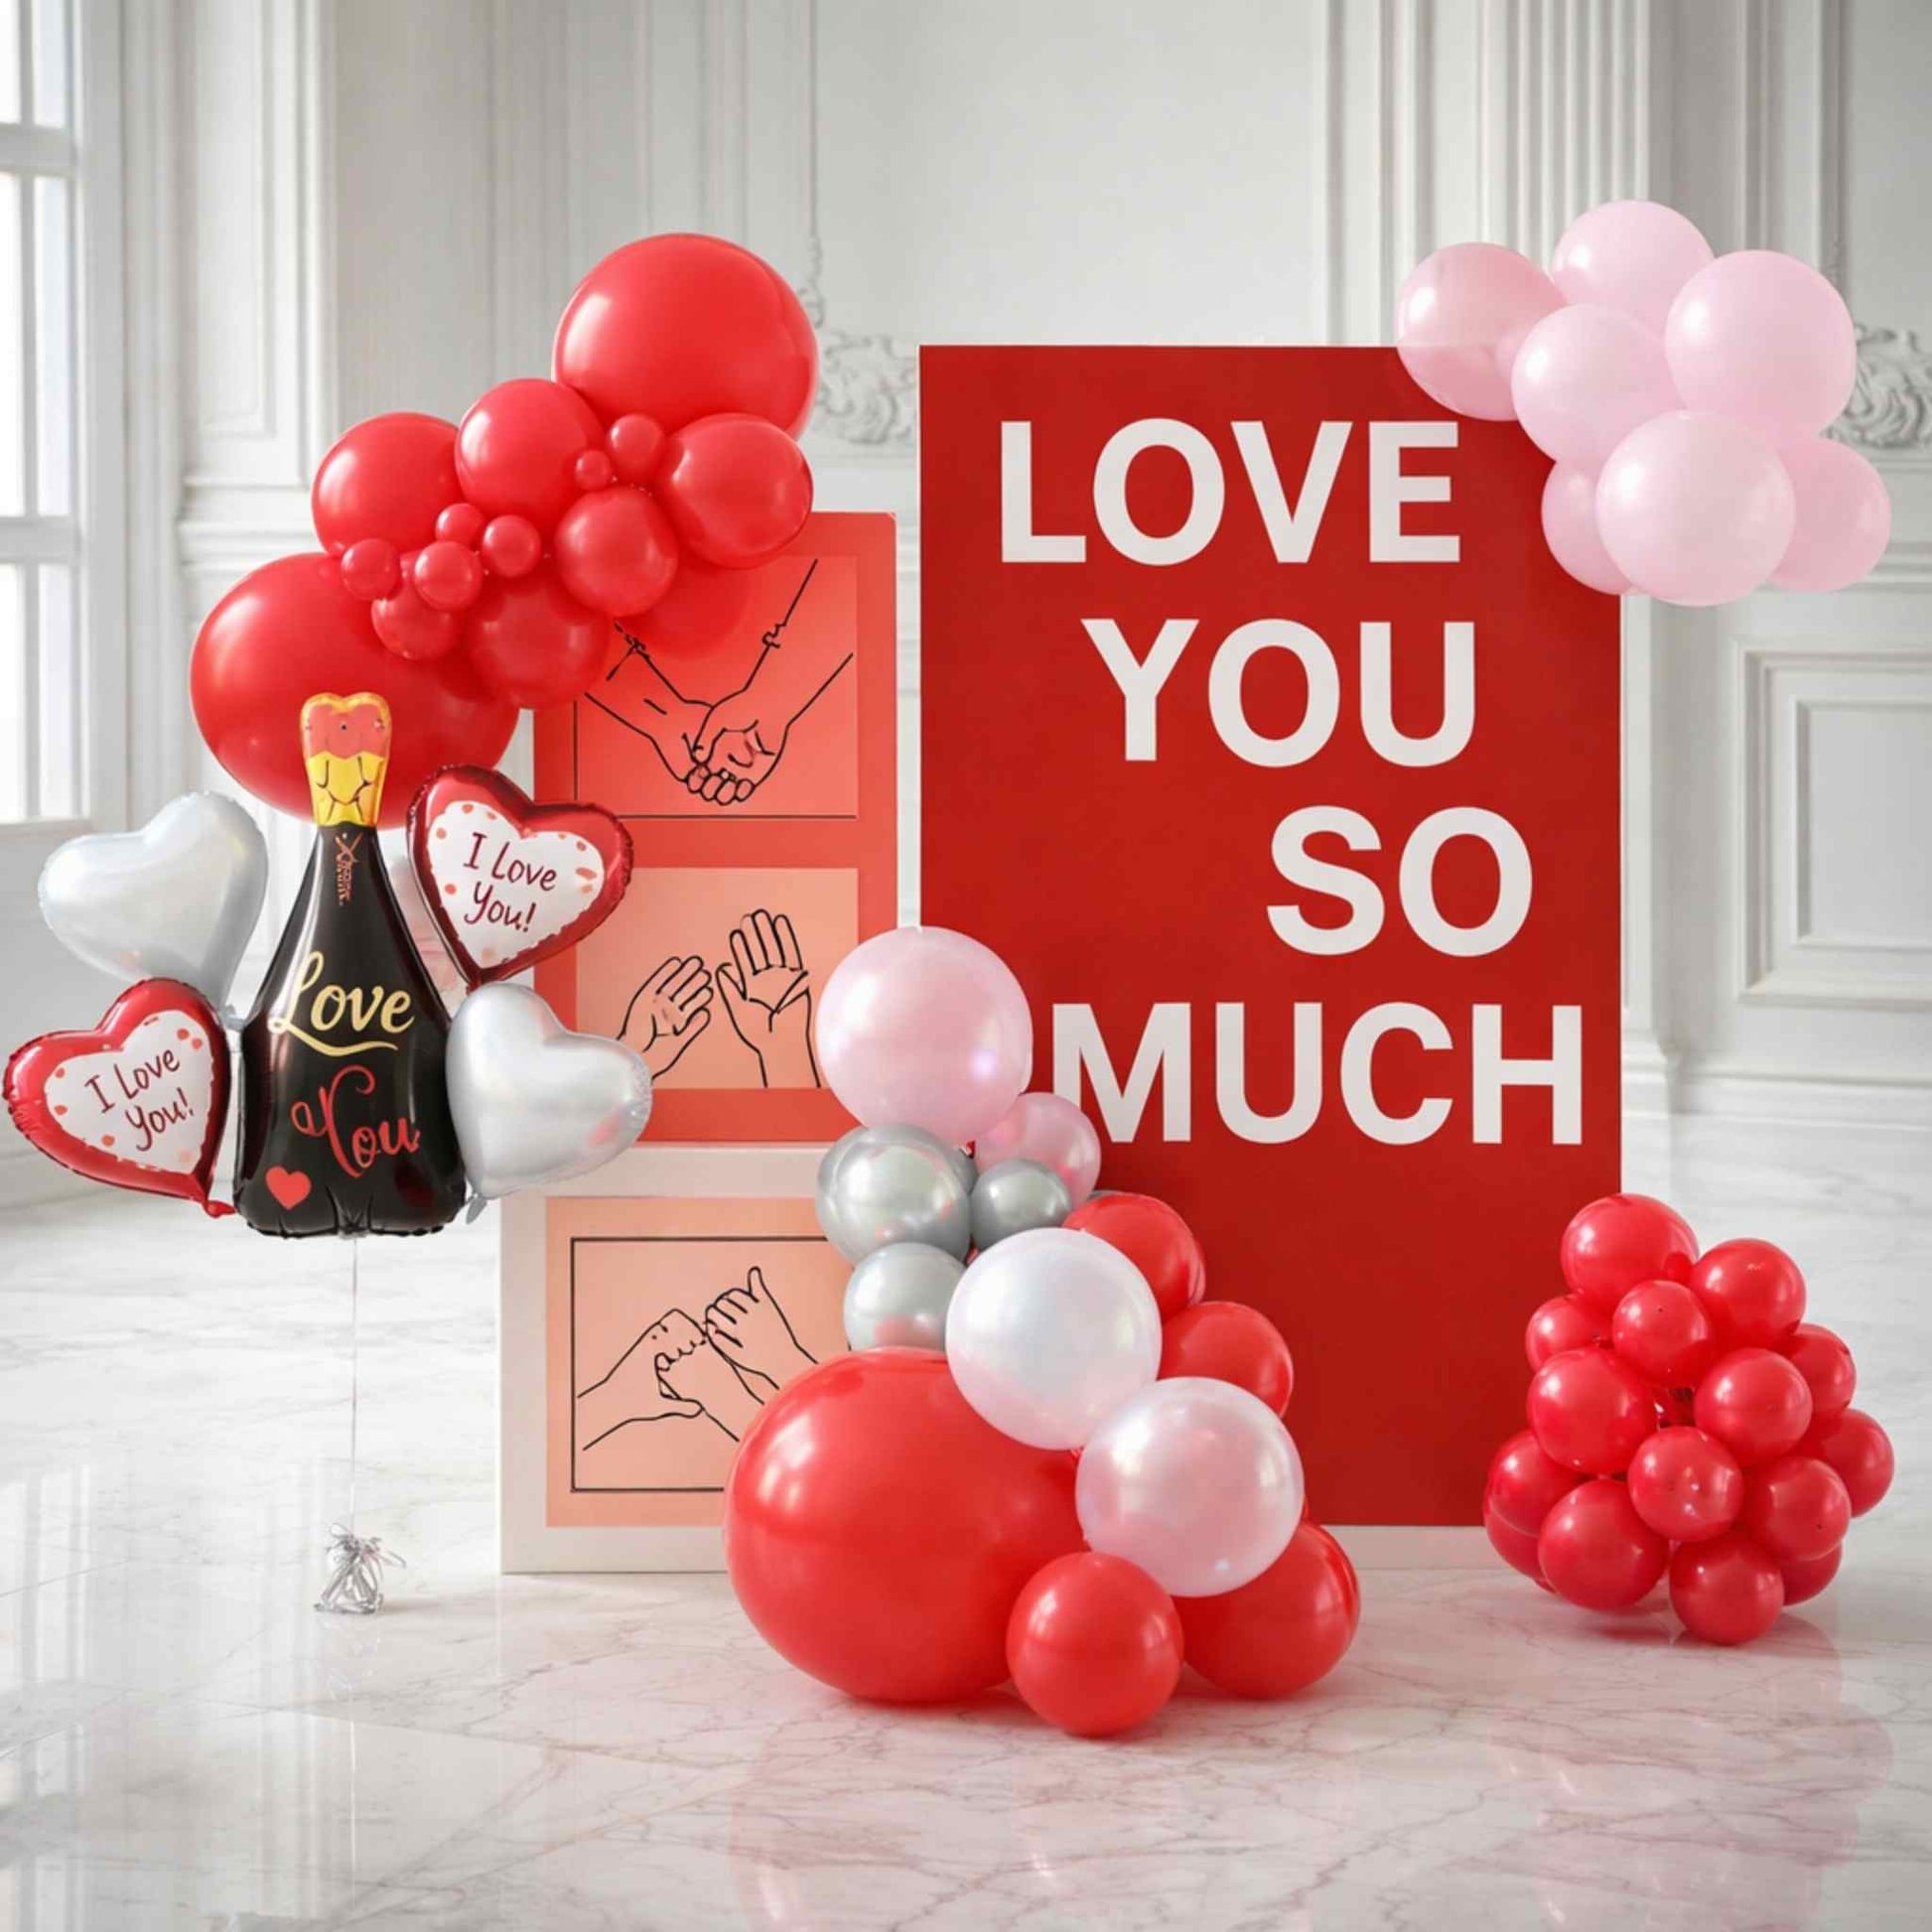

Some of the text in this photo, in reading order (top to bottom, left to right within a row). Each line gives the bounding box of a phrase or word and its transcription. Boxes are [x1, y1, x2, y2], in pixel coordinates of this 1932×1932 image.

[1001, 418, 1460, 565] LOVE
[1081, 619, 1475, 767] YOU
[463, 831, 557, 891] I Love
[464, 881, 536, 932] You!
[1267, 805, 1533, 957] SO
[267, 950, 415, 1056] Love
[84, 1049, 181, 1113] I Love
[125, 1087, 195, 1152] You!
[290, 1064, 421, 1177] You
[1052, 1001, 1583, 1145] MUCH
